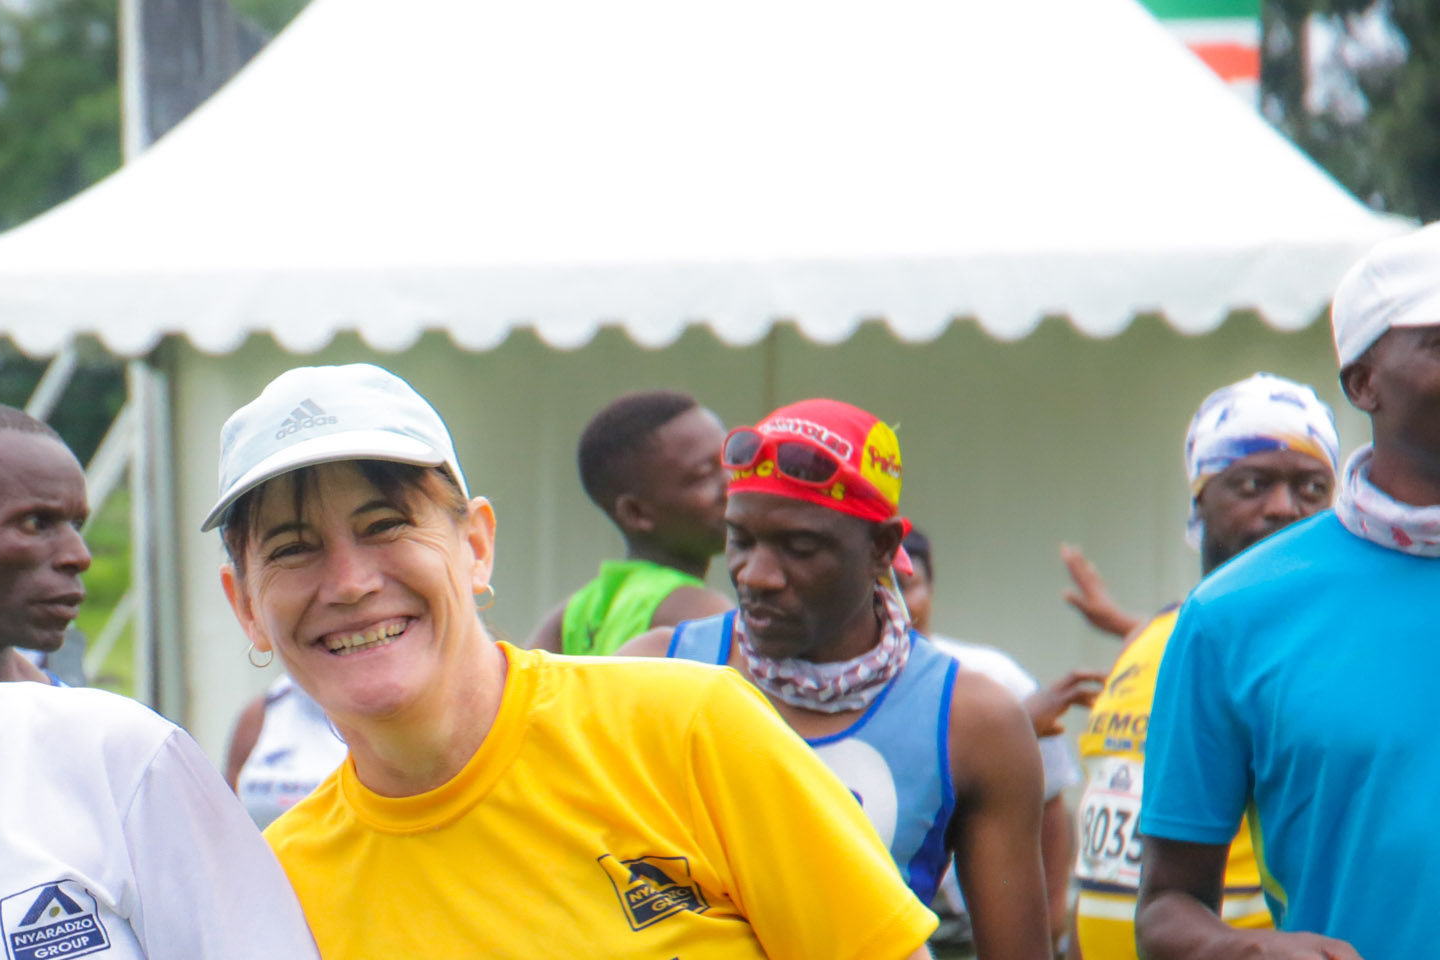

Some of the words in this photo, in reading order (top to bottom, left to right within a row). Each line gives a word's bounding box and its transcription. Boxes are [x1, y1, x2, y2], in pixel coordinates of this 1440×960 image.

[275, 413, 338, 441] adidas
[14, 917, 93, 946] NYARADZO
[34, 934, 90, 960] GROUP
